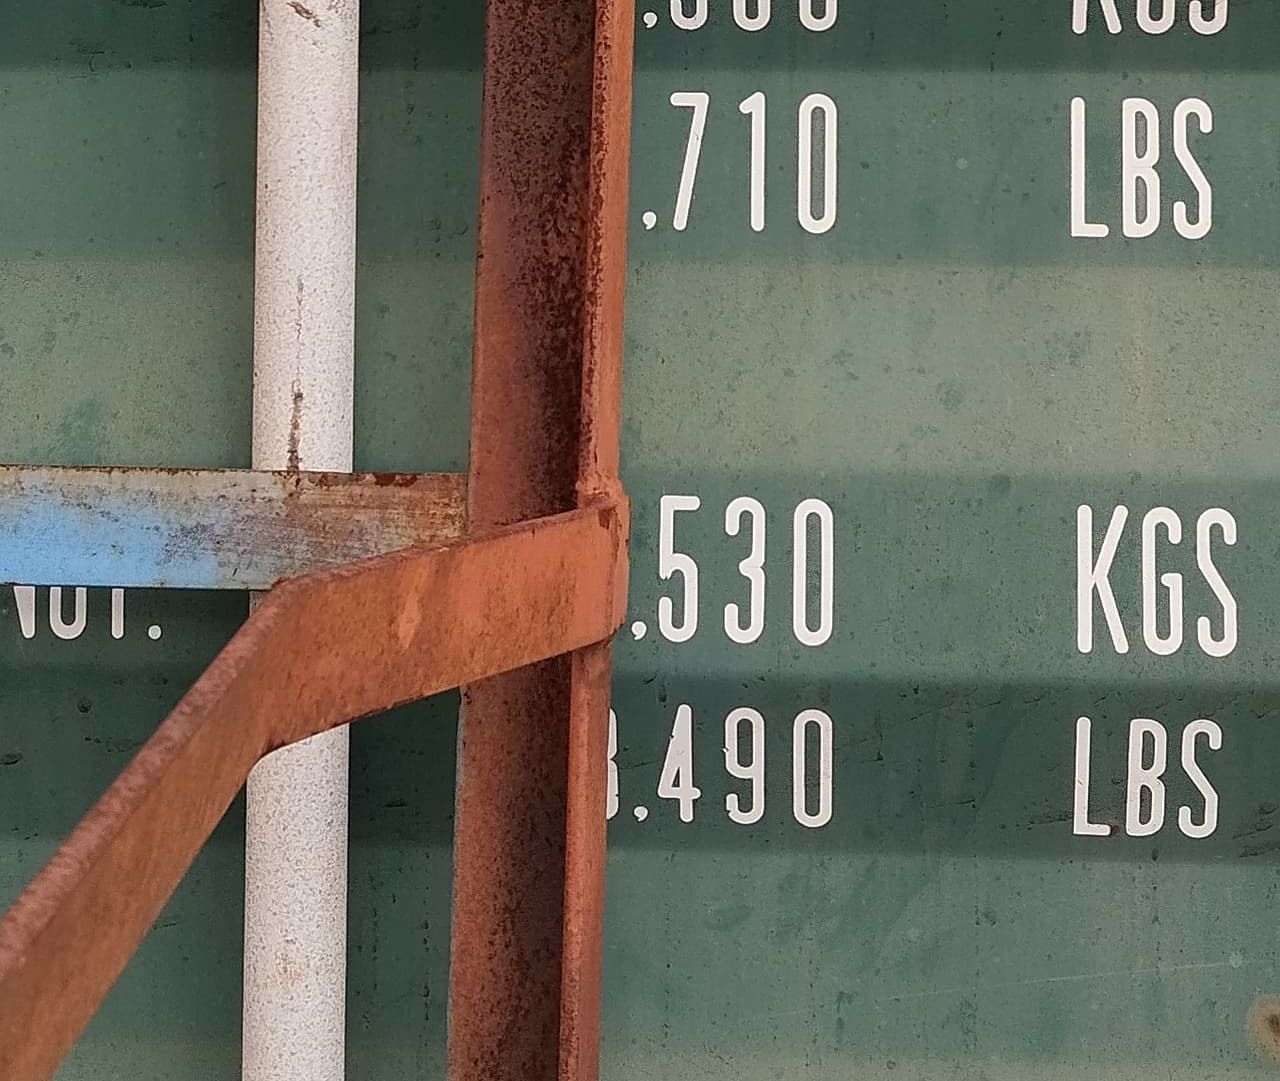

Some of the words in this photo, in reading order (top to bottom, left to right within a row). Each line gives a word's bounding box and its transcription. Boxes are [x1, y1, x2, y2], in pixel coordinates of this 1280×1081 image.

[1070, 96, 1213, 240] LBS
[1077, 504, 1238, 658] KGS
[605, 704, 833, 828] ,490
[1073, 716, 1222, 839] LBS
